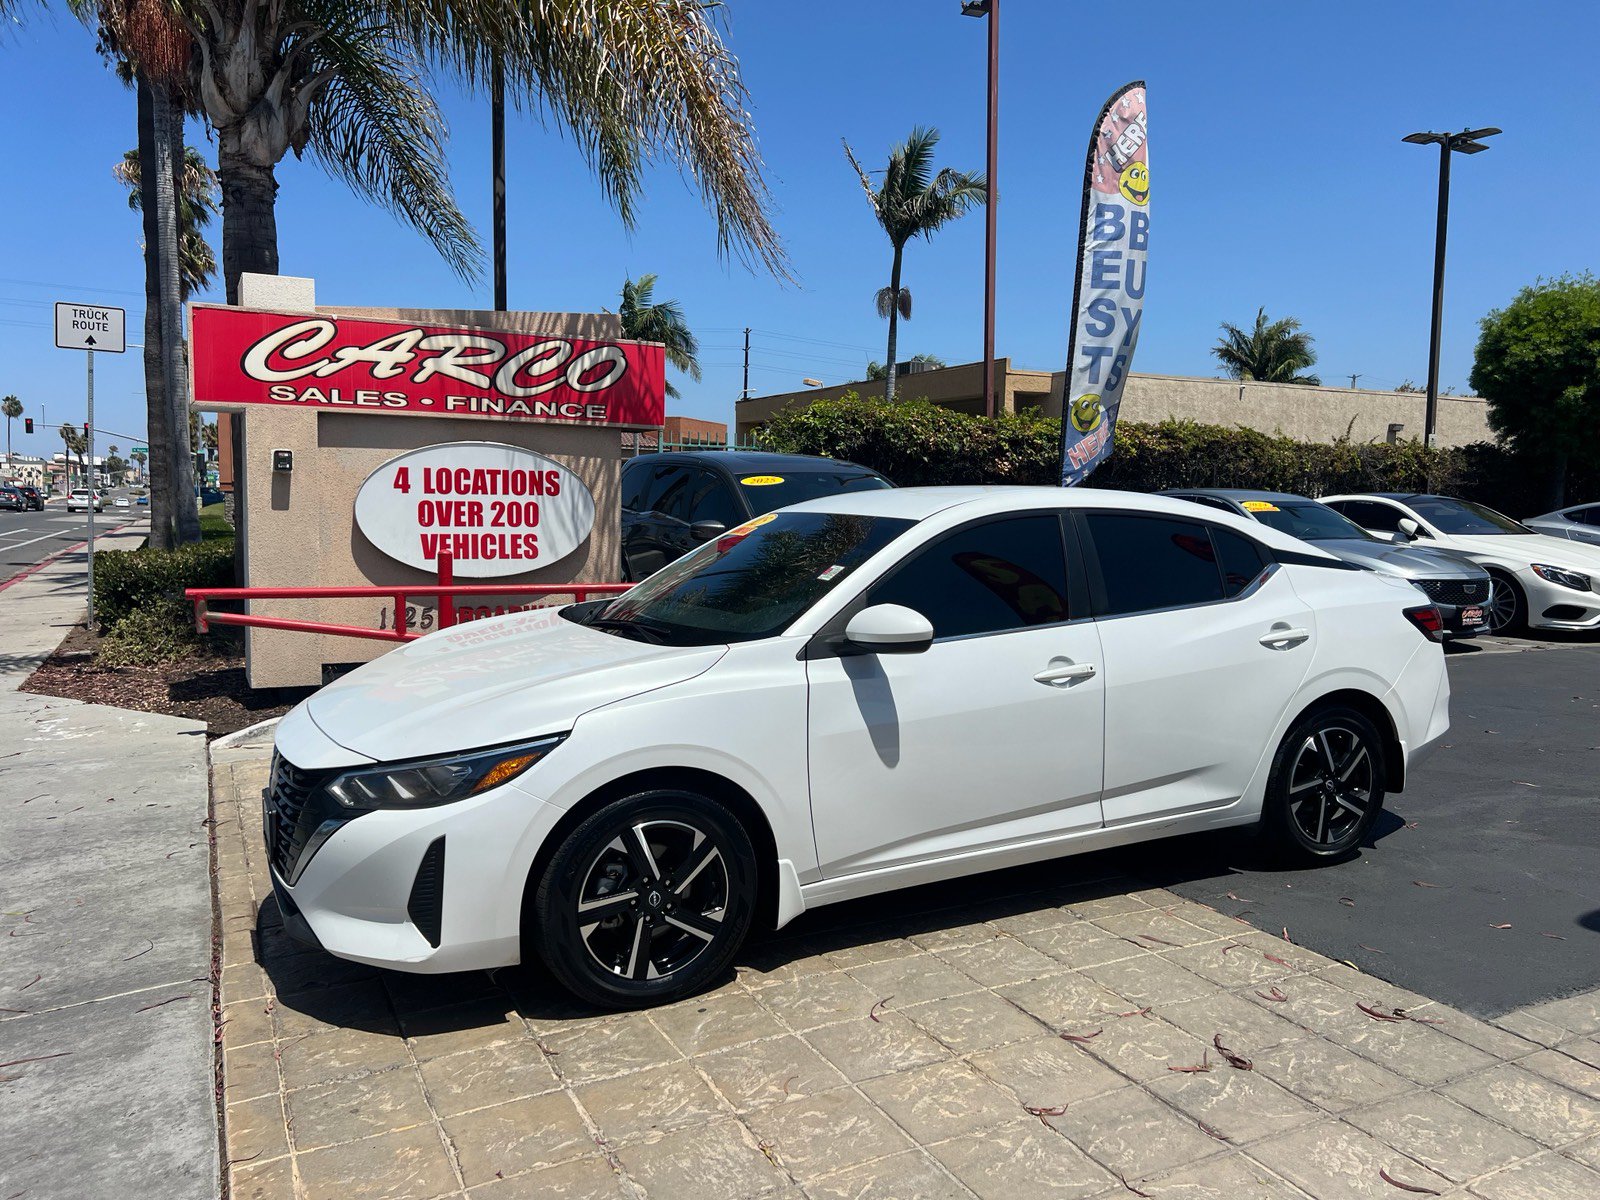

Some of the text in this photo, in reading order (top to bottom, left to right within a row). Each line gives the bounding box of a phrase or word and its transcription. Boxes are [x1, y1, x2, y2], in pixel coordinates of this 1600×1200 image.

[1082, 203, 1126, 385] BEST
[1104, 210, 1150, 392] BUYS
[72, 308, 109, 321] TRUCK
[72, 320, 109, 332] ROUTE
[241, 319, 628, 398] CARCO
[269, 385, 607, 420] SALES FINANCE
[393, 467, 561, 497] 4 LOCATIONS
[417, 500, 540, 527] OVER 200
[420, 533, 539, 560] VEHICLES
